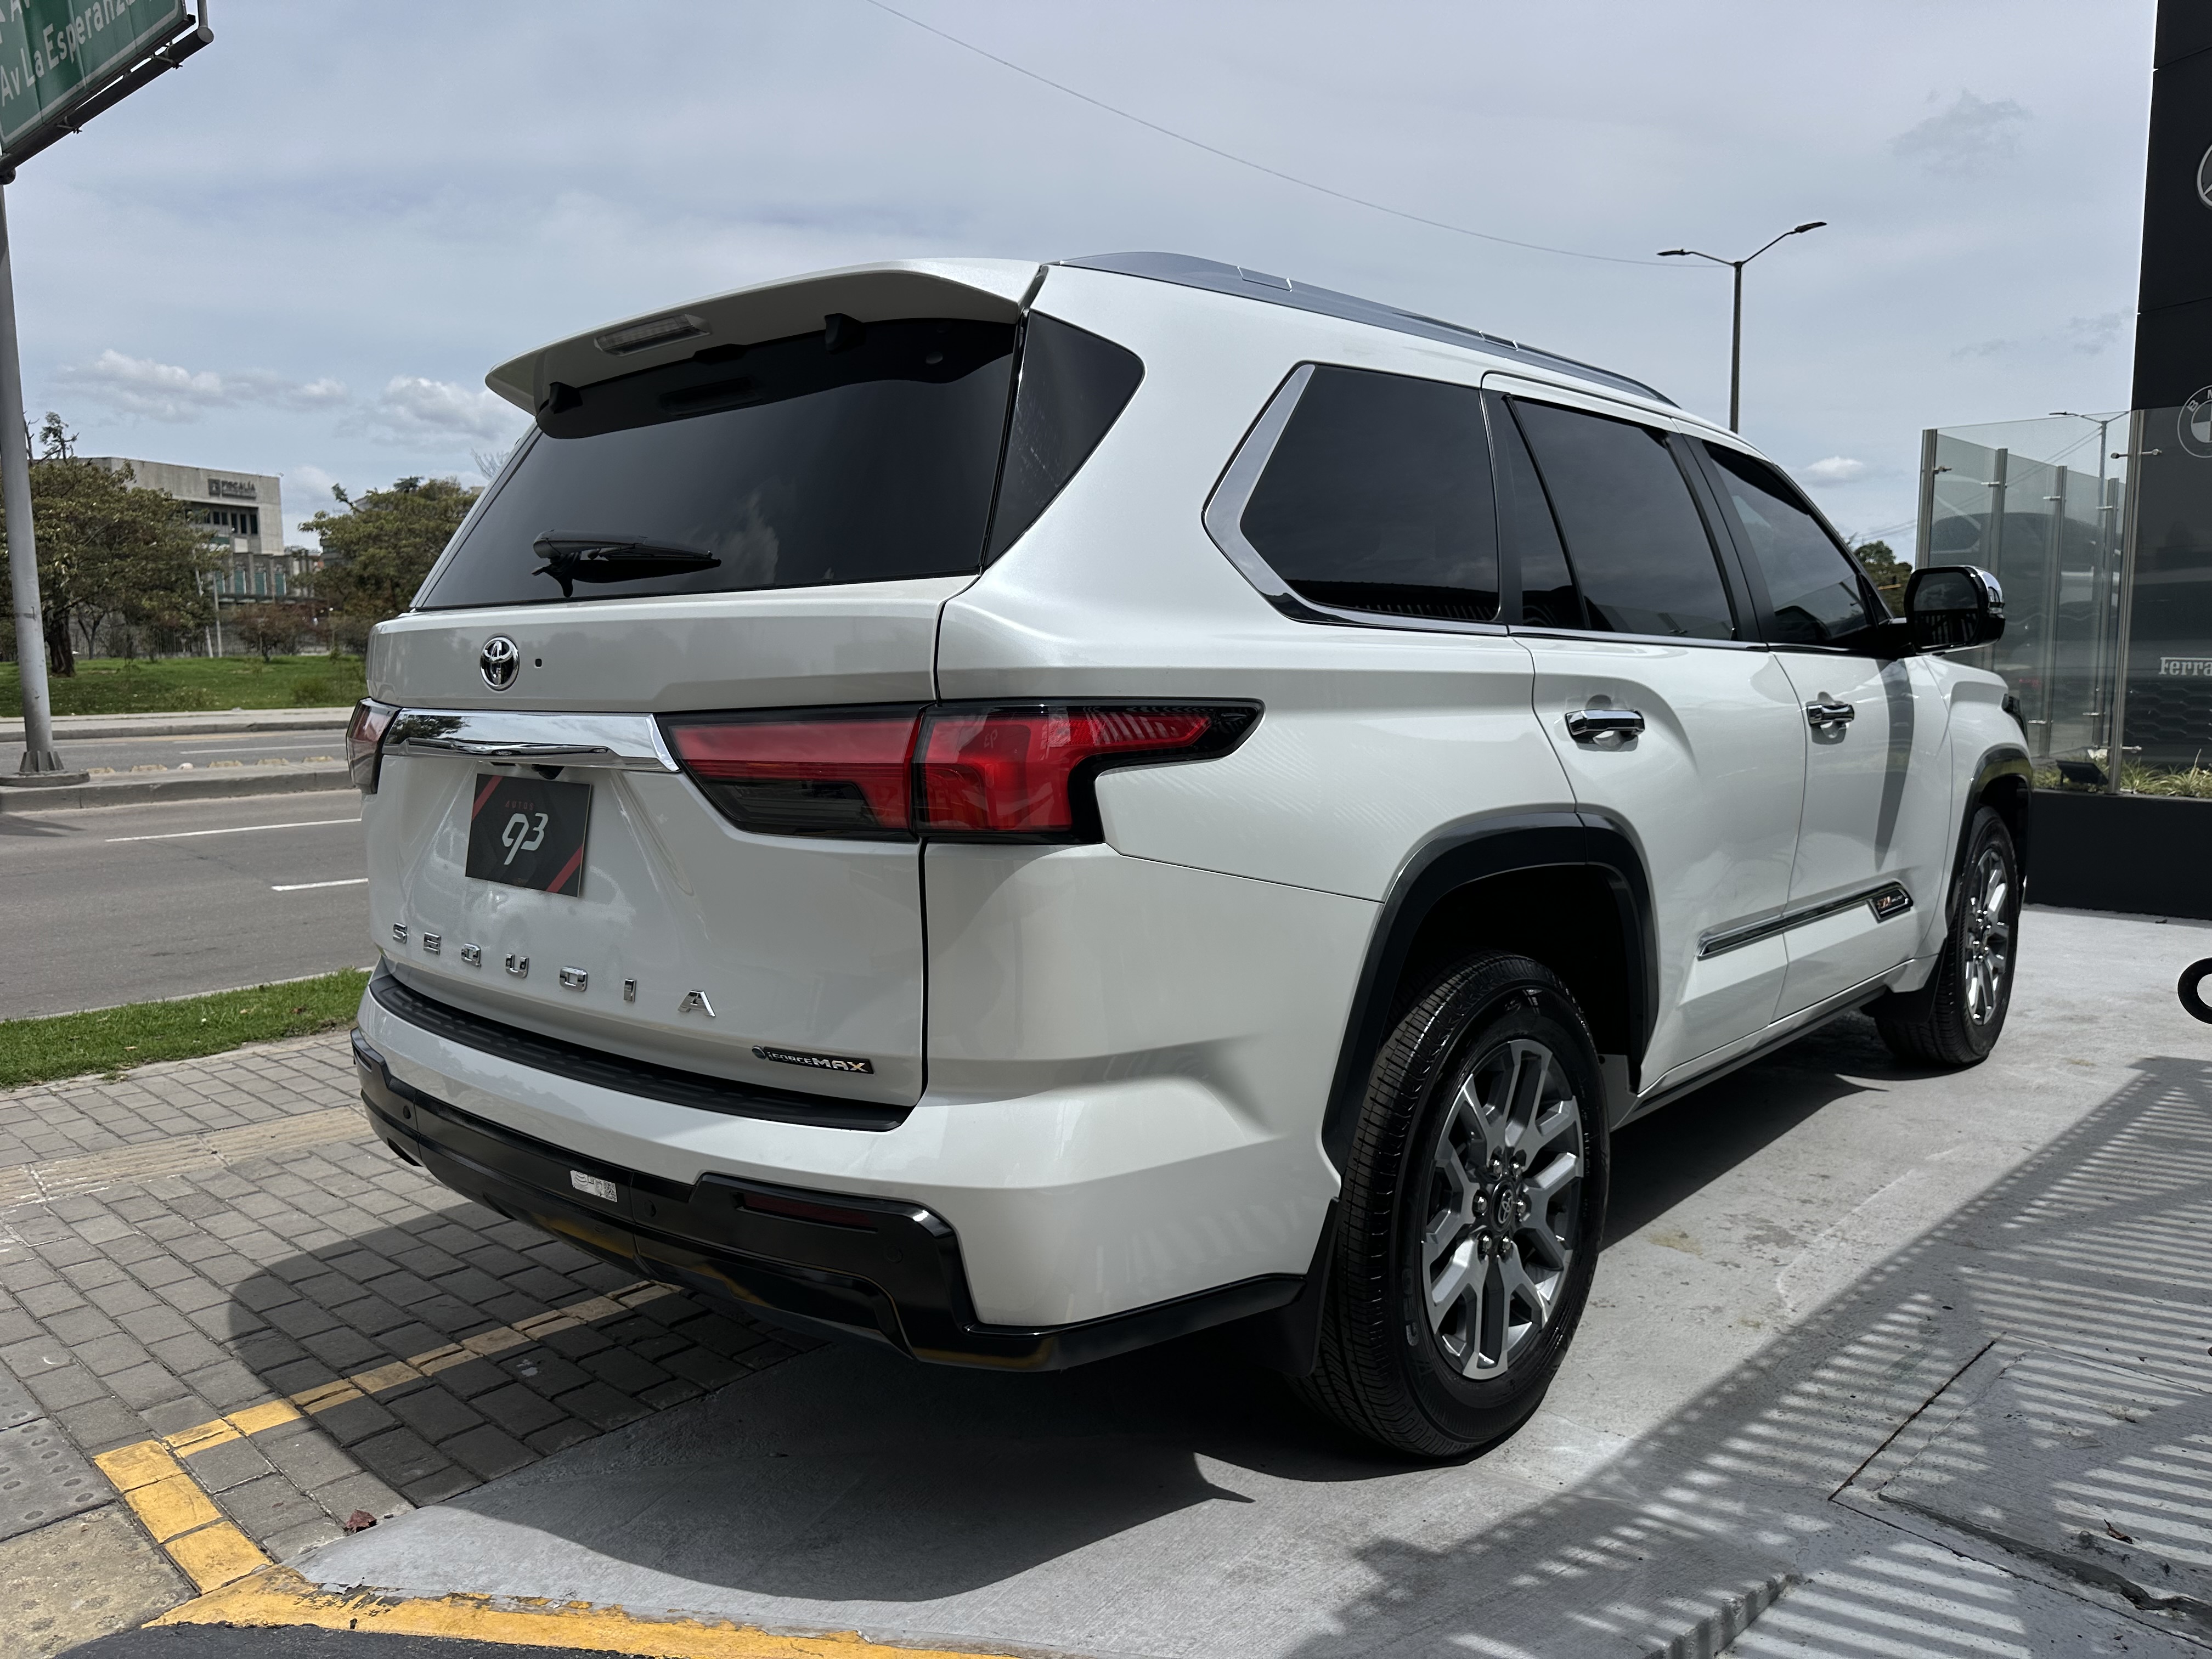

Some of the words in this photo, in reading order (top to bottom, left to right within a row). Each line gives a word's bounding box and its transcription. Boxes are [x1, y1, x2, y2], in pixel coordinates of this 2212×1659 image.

[1, 65, 20, 107] Av
[20, 48, 44, 88] La
[505, 800, 535, 811] AUTOS
[393, 922, 715, 1017] SEQUOIA
